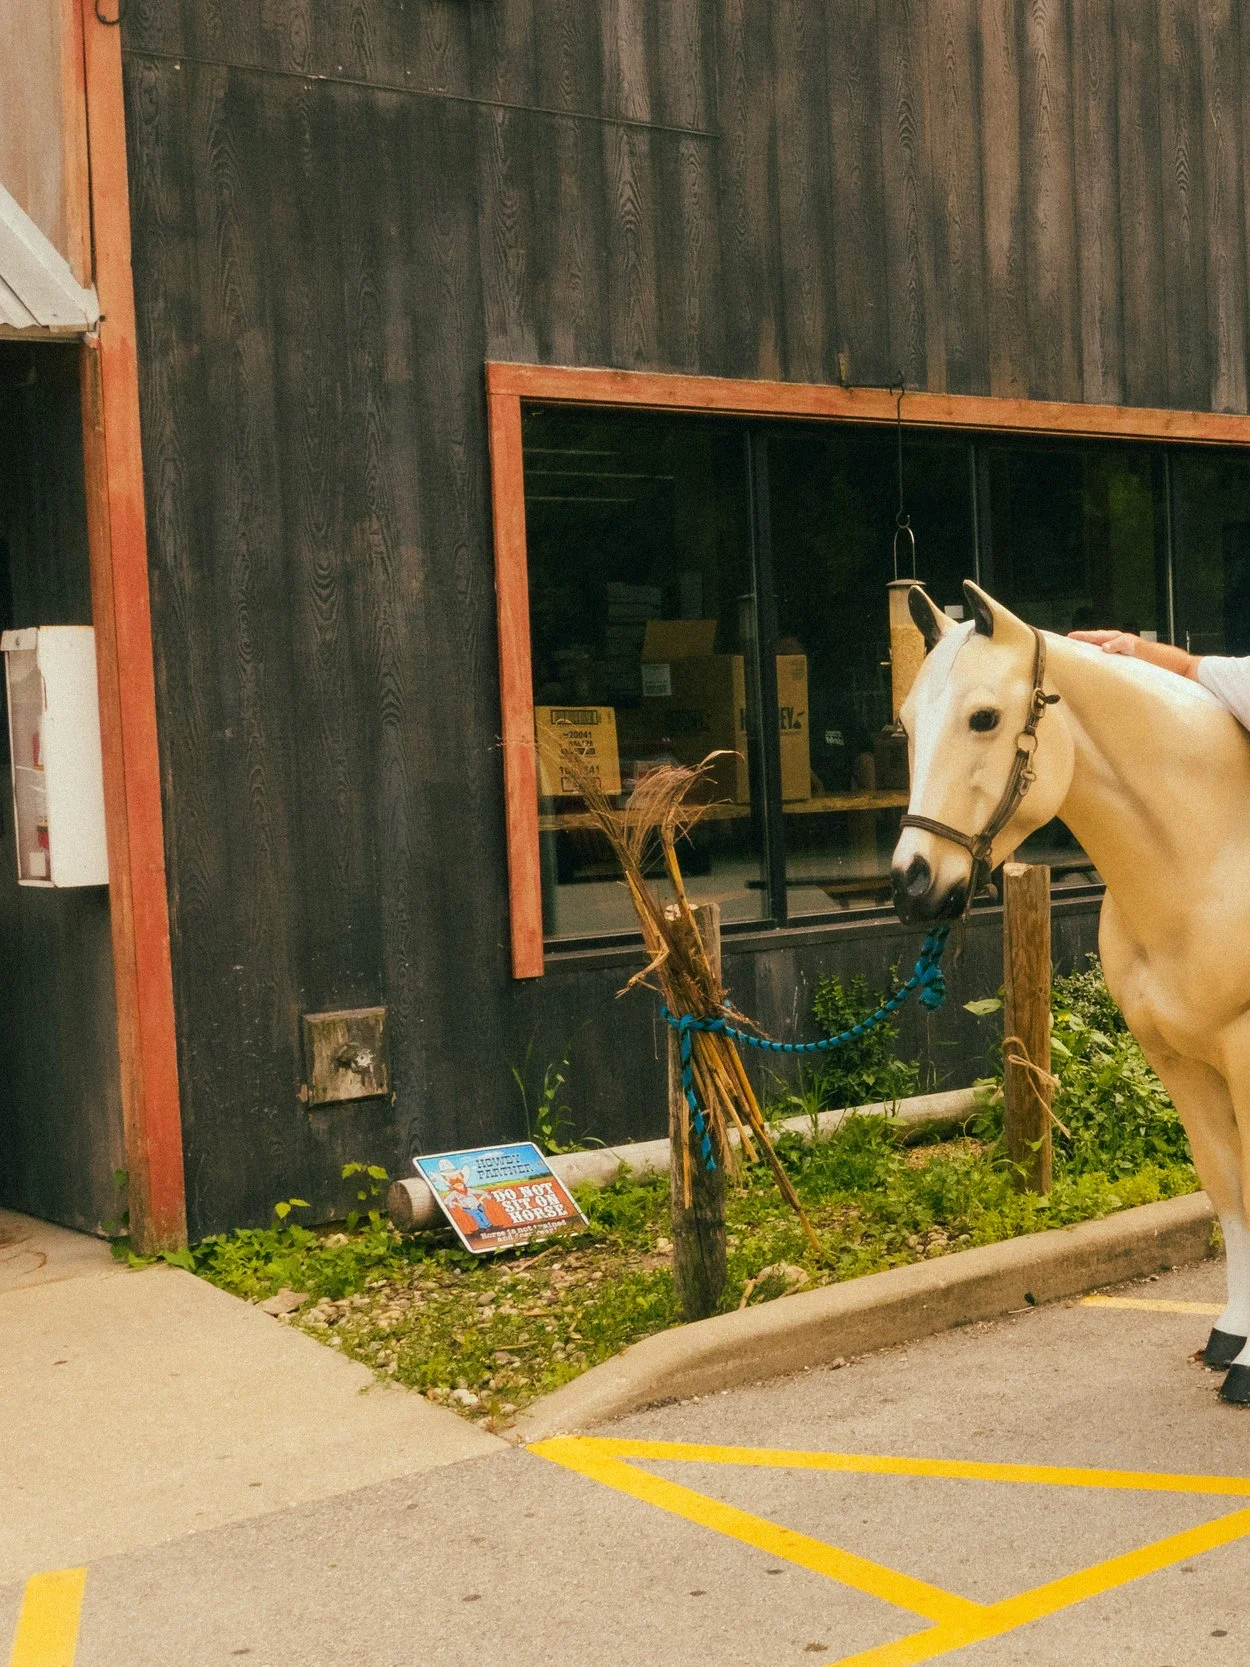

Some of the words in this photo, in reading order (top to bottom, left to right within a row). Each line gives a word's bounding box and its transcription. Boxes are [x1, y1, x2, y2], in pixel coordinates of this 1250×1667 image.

[476, 1154, 520, 1168] HOWDY
[477, 1164, 534, 1179] PARTNER
[491, 1188, 517, 1202] DO
[518, 1182, 555, 1197] NOT
[502, 1197, 532, 1213] SIT
[535, 1193, 560, 1207] ON
[508, 1203, 569, 1223] HORSE
[480, 1231, 506, 1239] Horse
[517, 1225, 533, 1234] not
